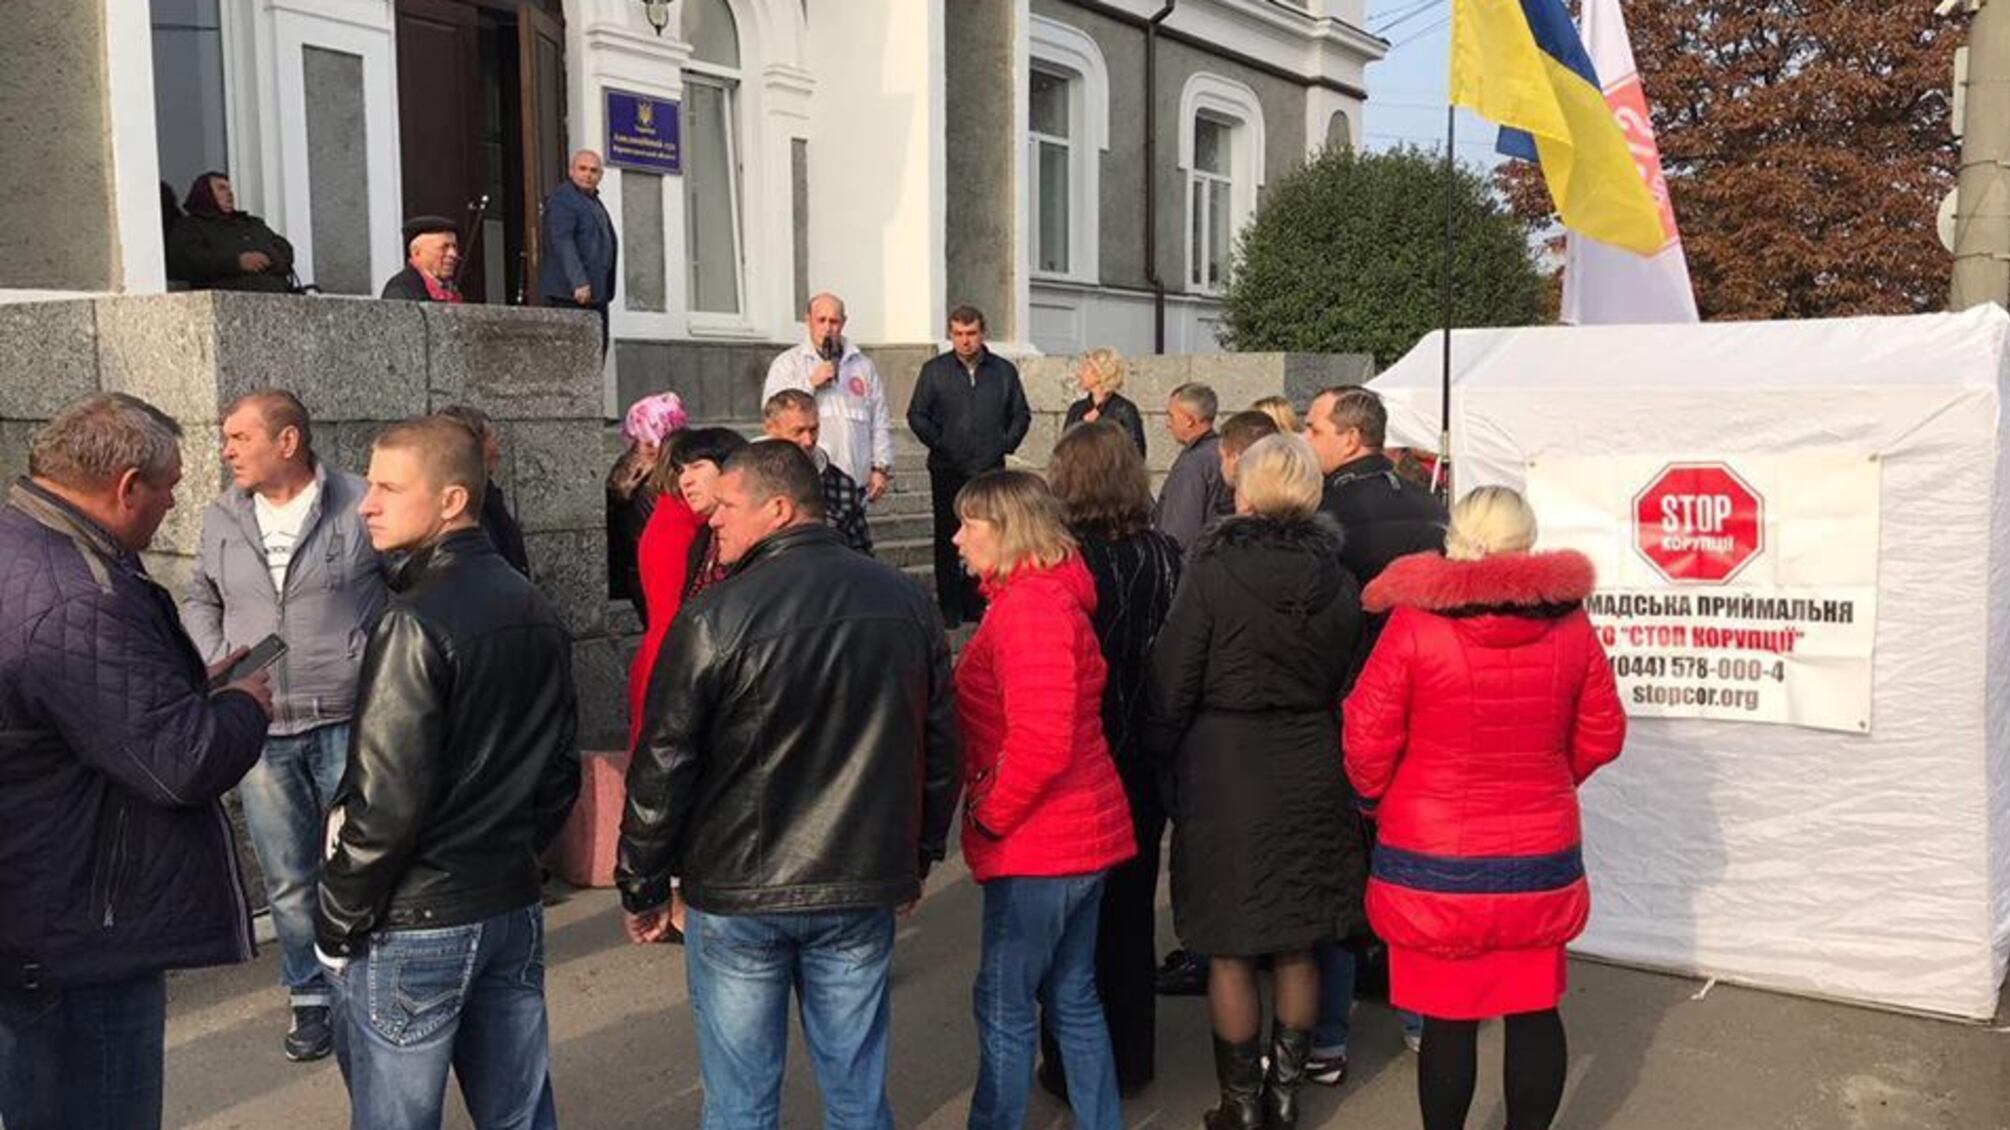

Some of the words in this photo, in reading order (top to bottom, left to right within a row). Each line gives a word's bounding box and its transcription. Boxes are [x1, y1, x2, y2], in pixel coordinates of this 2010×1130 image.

[1660, 494, 1733, 533] STOP
[1587, 594, 1692, 617] МАДСЬКА
[1697, 593, 1854, 623] ПРИЙМАЛЬНЯ
[1620, 626, 1687, 648] "СТОП
[1608, 655, 1666, 678] (044)
[1671, 657, 1785, 683] 578-000-4
[1632, 683, 1760, 710] stopcor.org
